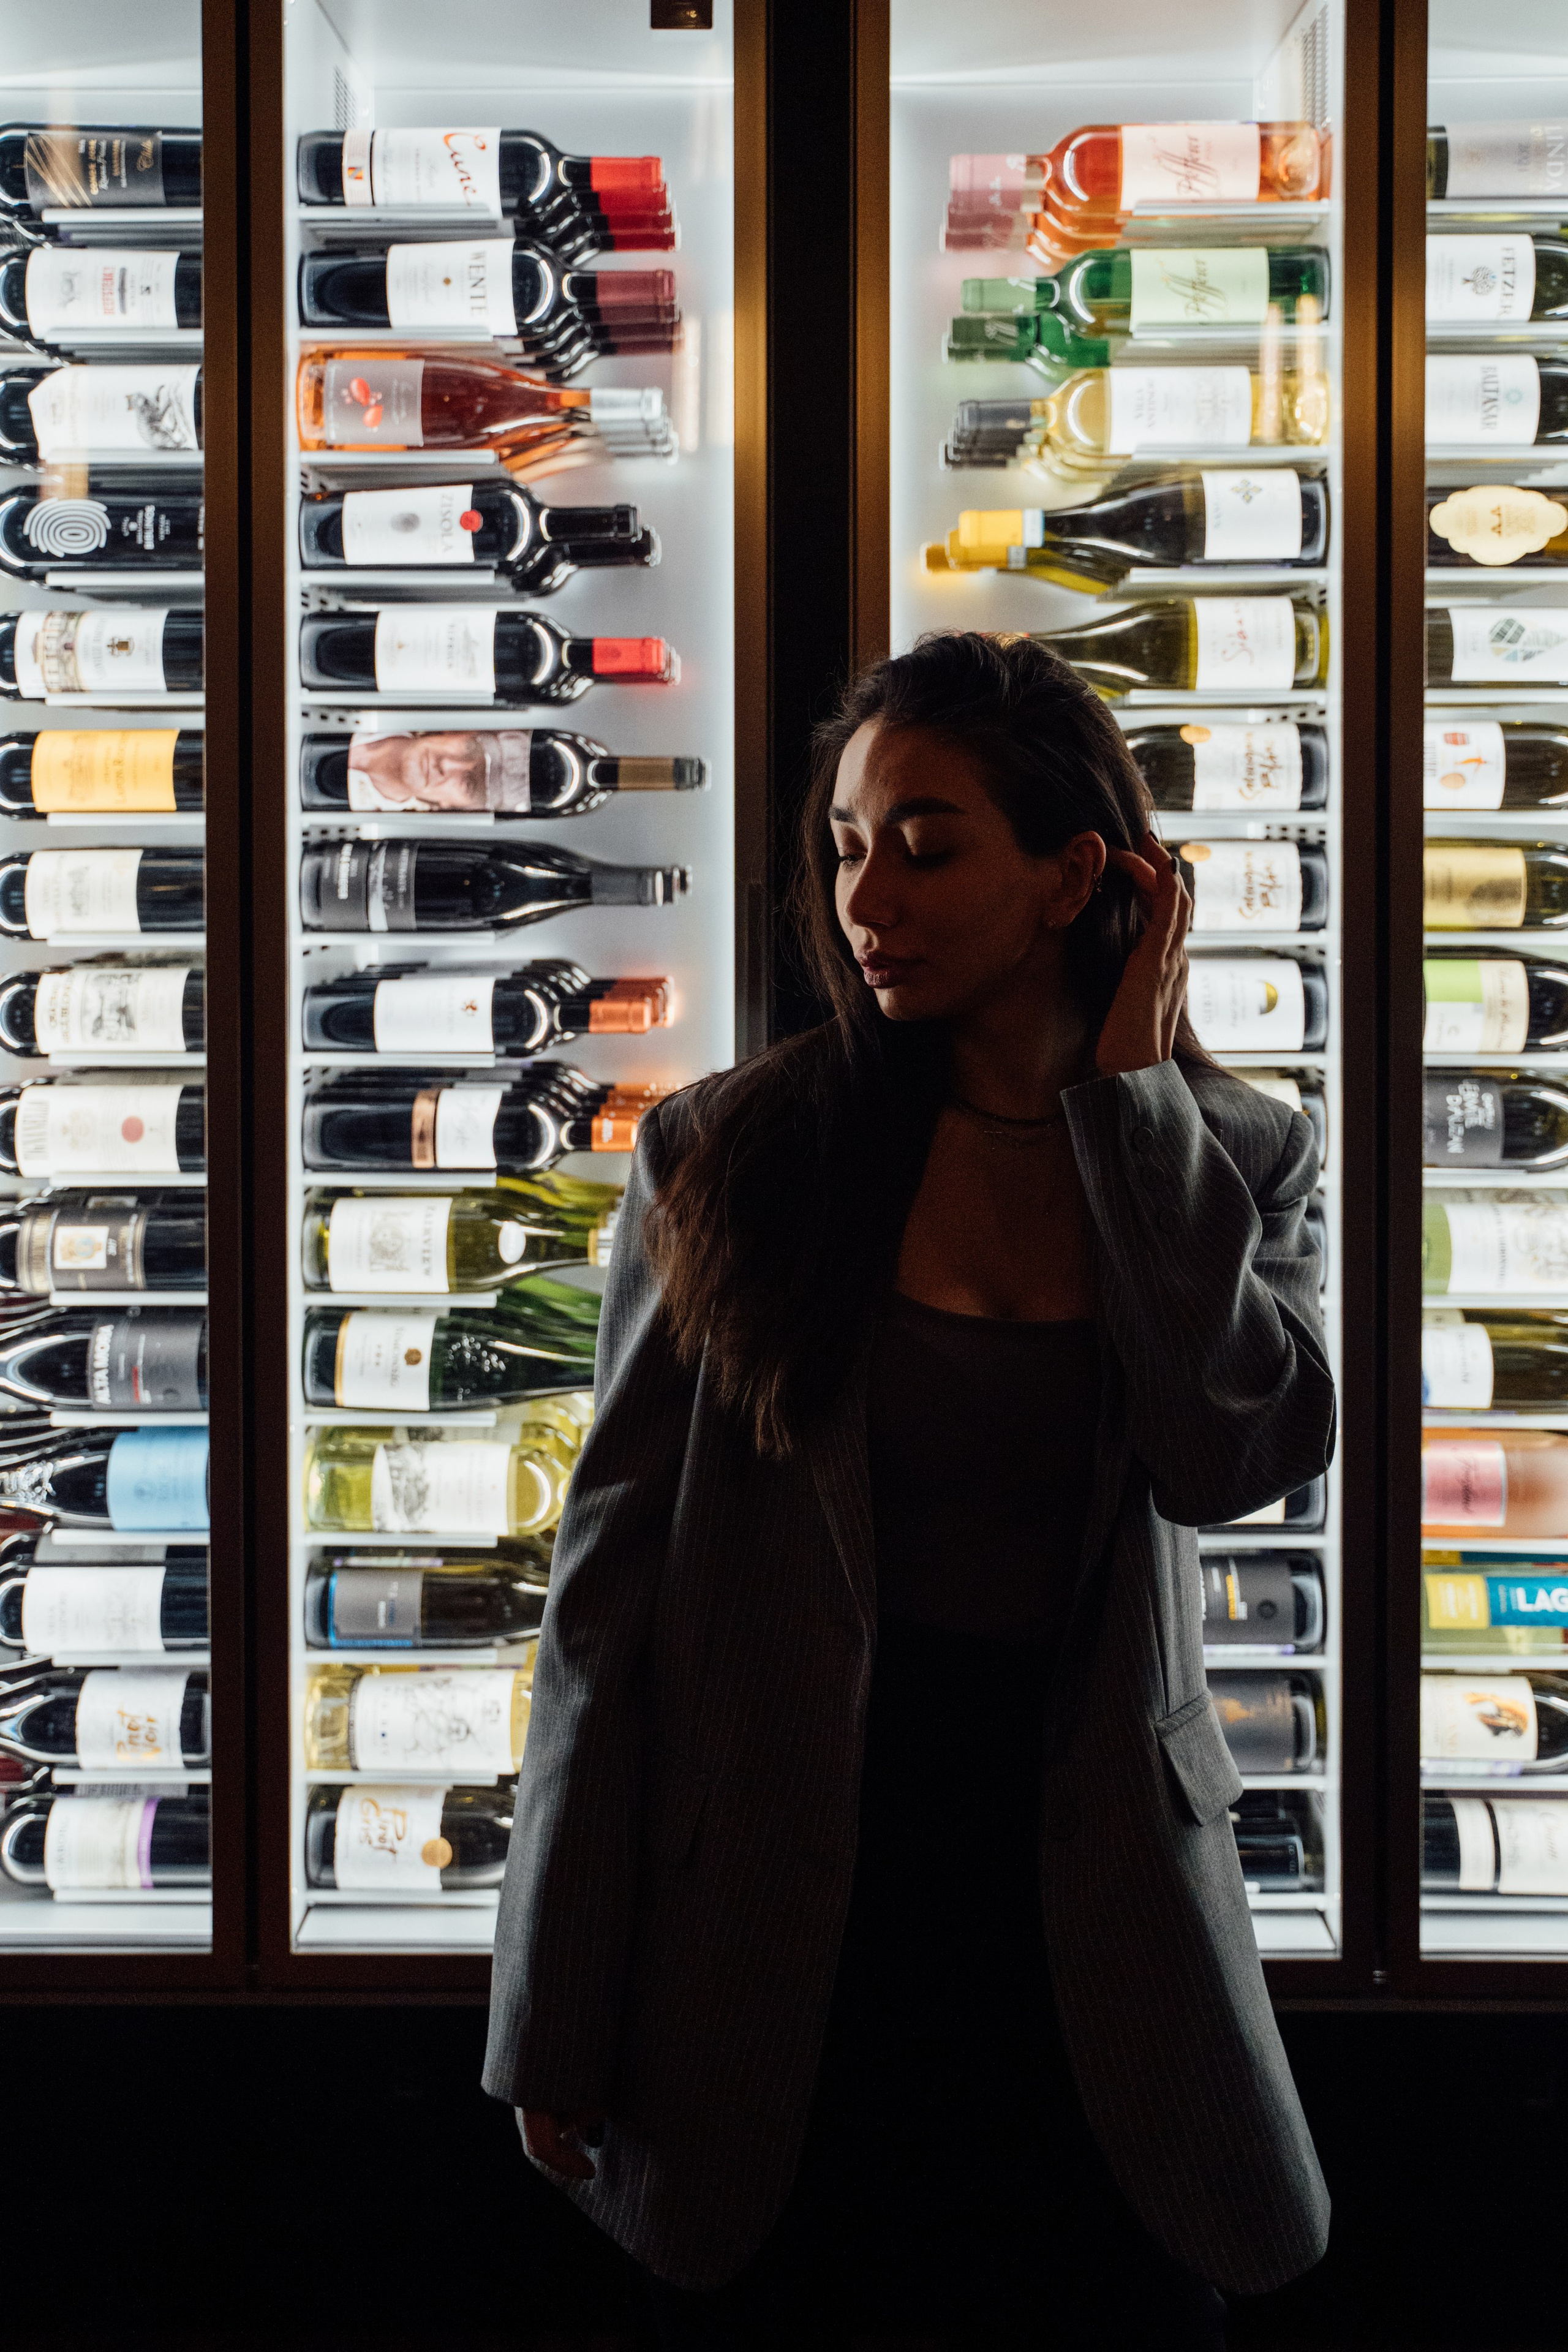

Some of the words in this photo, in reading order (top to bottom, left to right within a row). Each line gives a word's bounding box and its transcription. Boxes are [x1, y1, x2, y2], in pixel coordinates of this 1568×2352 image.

[442, 132, 488, 206] Cune
[467, 250, 489, 317] WENTE
[1499, 247, 1518, 318] FETZER
[1480, 366, 1499, 431] BALTASAR
[440, 492, 454, 552] ZISOLA
[93, 1324, 115, 1368] MORA
[93, 1368, 111, 1406] ALTA
[115, 1703, 143, 1762] Pinot
[140, 1713, 162, 1762] Noir
[358, 1798, 382, 1845] Gris
[372, 1808, 409, 1864] Pinot
